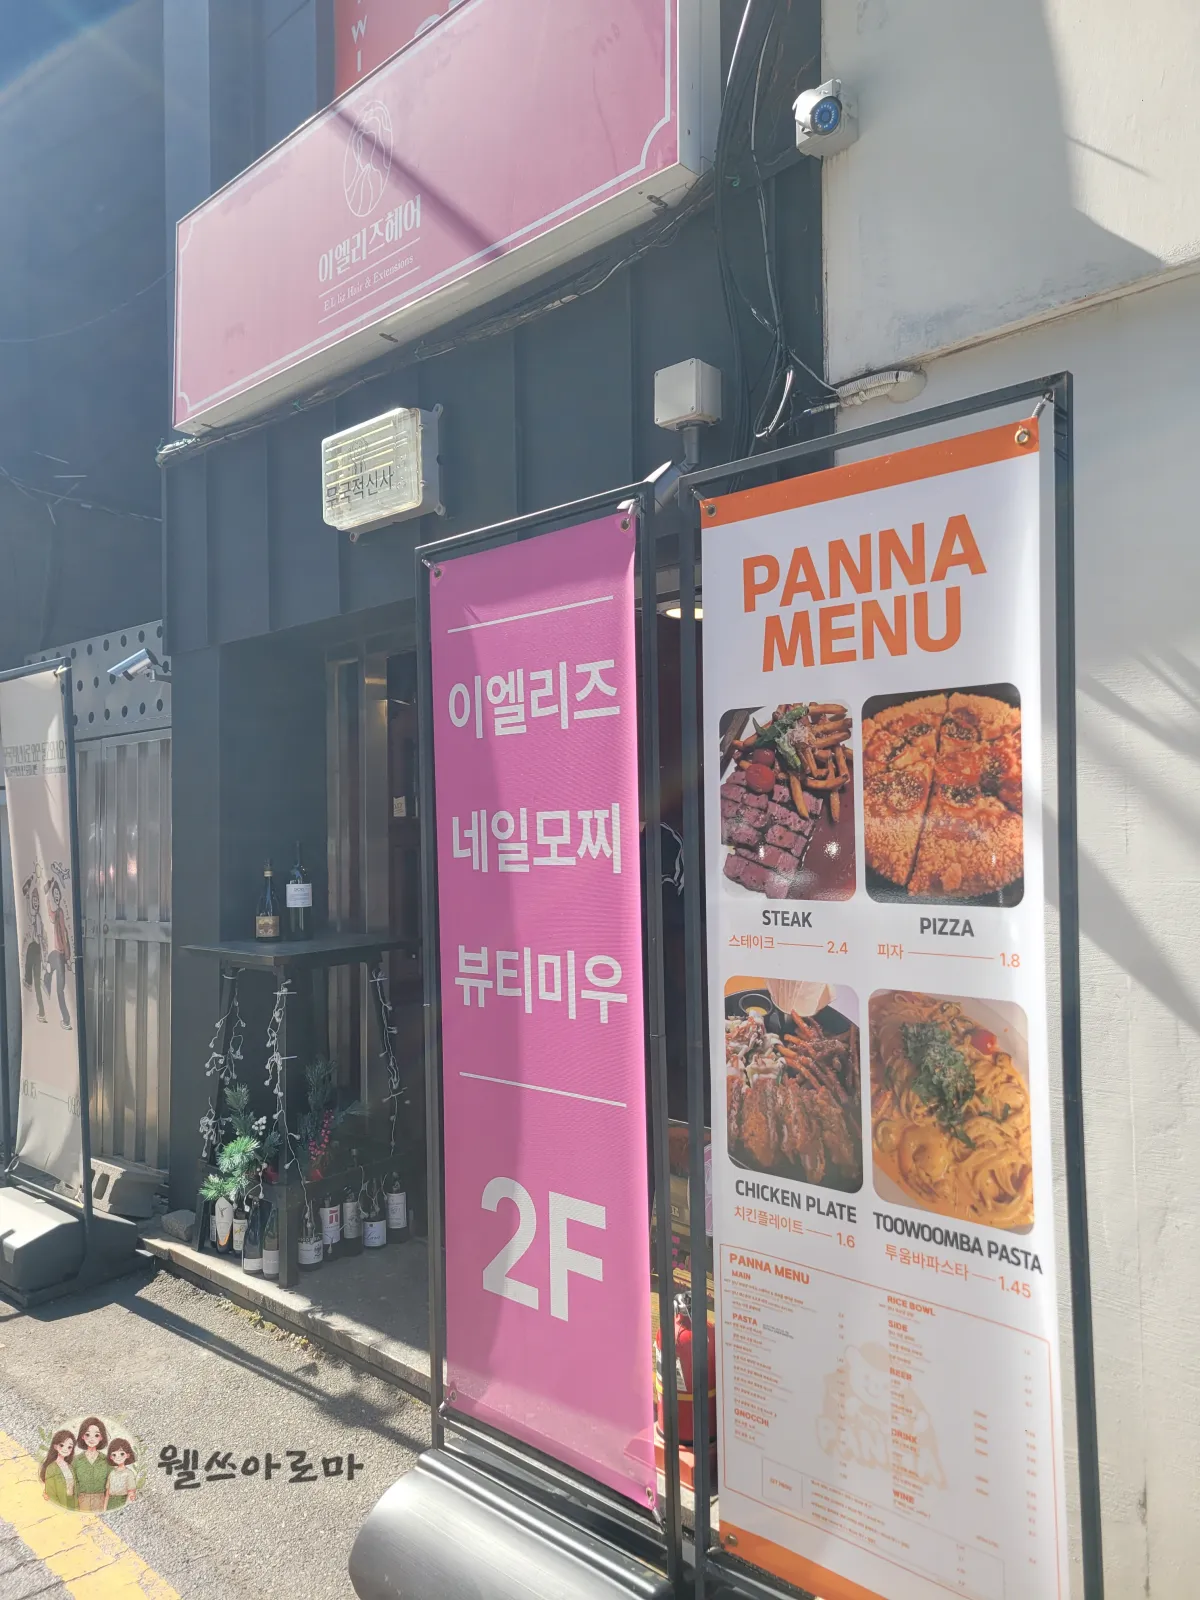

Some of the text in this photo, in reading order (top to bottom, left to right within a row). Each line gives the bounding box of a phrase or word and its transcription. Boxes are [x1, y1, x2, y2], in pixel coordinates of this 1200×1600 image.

[318, 194, 421, 282] 이엘리즈헤어
[347, 281, 362, 298] Hair
[364, 277, 372, 289] &
[373, 255, 414, 283] Extensions
[742, 514, 988, 613] PANNA
[762, 586, 962, 673] MENU
[448, 659, 621, 739] 이엘리즈
[452, 802, 622, 874] 네일모찌
[762, 909, 813, 928] STEAK
[919, 917, 975, 938] PIZZA
[728, 935, 848, 955] 스테이크 2.4
[877, 943, 1021, 968] 피자 1.8
[454, 945, 628, 1024] 뷰티미우
[735, 1179, 857, 1224] CHICKEN PLATE
[734, 1205, 856, 1248] 치킨플레이트 1.6
[481, 1176, 606, 1322] 2F
[873, 1211, 1044, 1275] TOOWOOMBA PASTA
[729, 1253, 810, 1285] PANNA MENU
[732, 1269, 751, 1280] MAIN
[884, 1243, 1032, 1299] 투움바파스타 1.45
[732, 1313, 758, 1326] PASTA
[887, 1295, 907, 1308] RICE
[909, 1300, 936, 1316] BOWL
[888, 1320, 908, 1332] SIDE
[889, 1367, 913, 1381] BEER
[734, 1408, 769, 1427] GNOCCHI
[891, 1428, 918, 1444] DRINK
[892, 1489, 915, 1504] WINE
